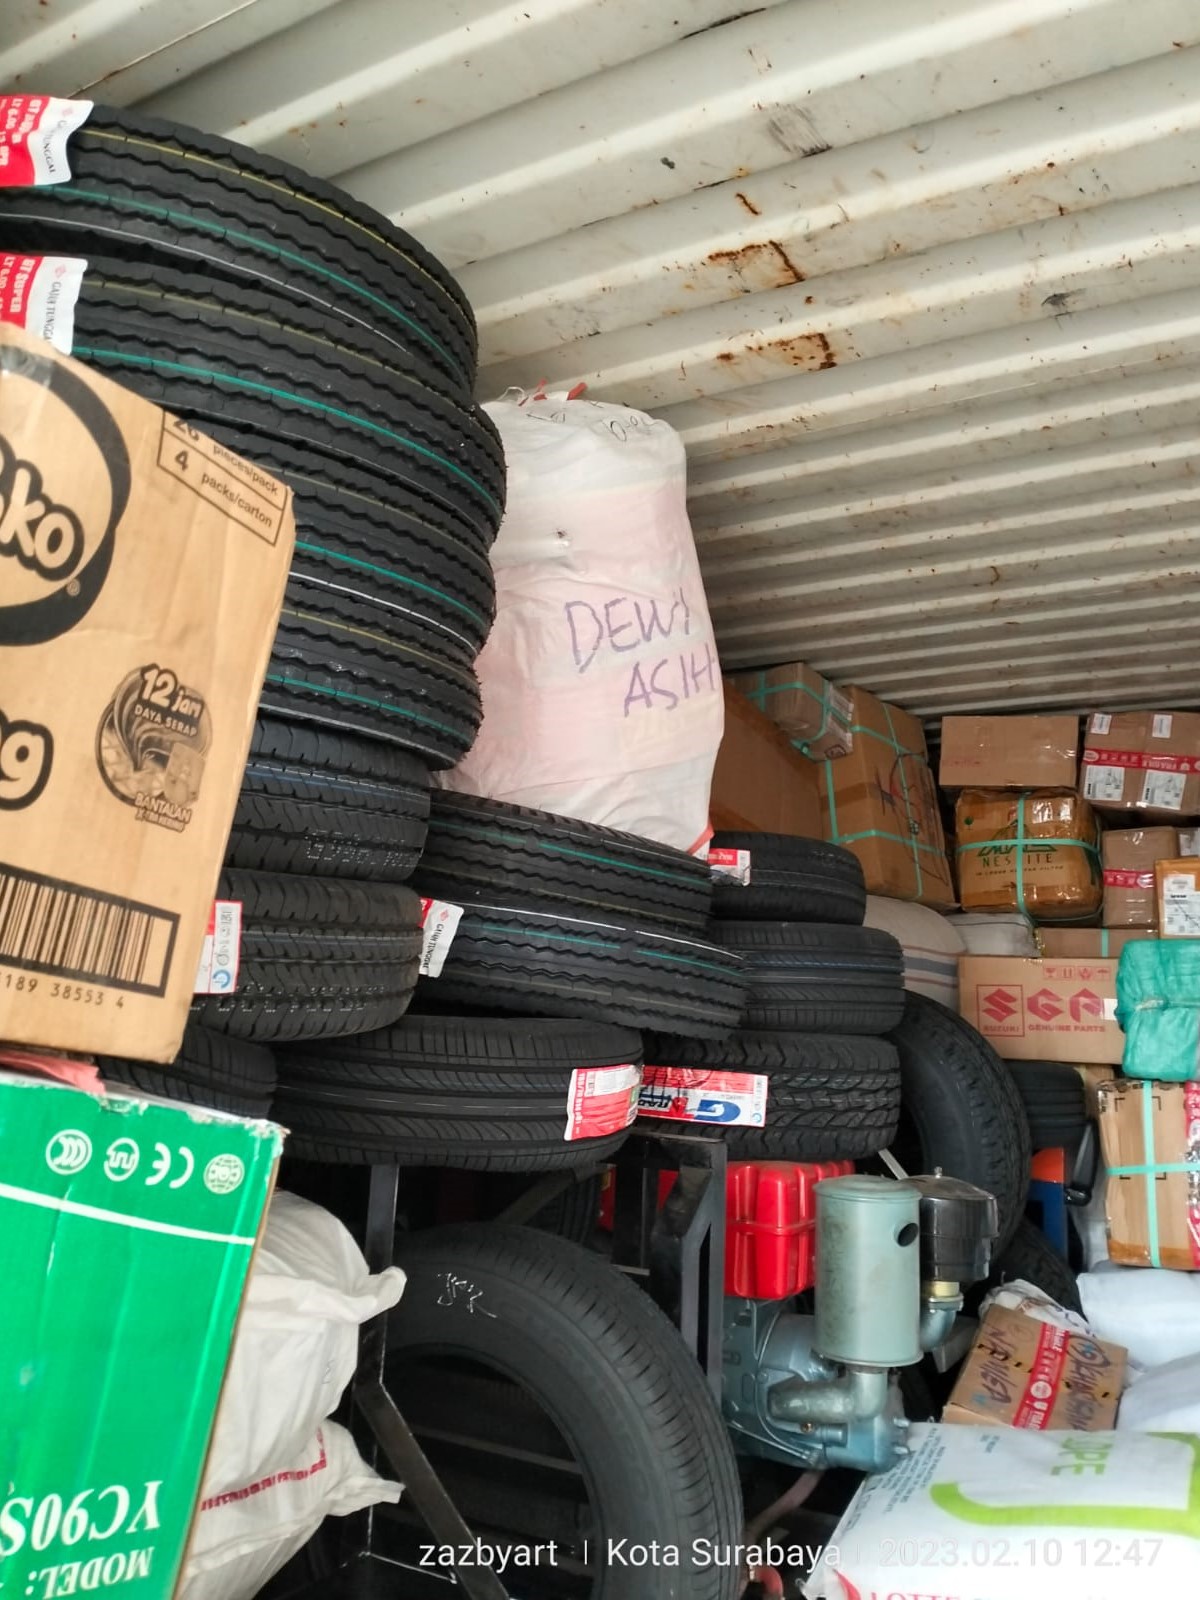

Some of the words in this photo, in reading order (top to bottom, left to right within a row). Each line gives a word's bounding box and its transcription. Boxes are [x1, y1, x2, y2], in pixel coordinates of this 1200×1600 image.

[174, 450, 189, 472] 4
[201, 472, 274, 528] packs/carton
[0, 464, 78, 572] ko
[564, 587, 690, 675] DEWI
[142, 667, 176, 709] 12
[171, 689, 204, 719] jam
[623, 642, 716, 718] ASIH
[133, 703, 164, 725] DAYA
[164, 717, 199, 738] SERAP
[133, 793, 192, 824] BANTALAN
[982, 853, 1053, 868] NESITE
[0, 972, 38, 993] 189
[50, 982, 105, 1006] 38553
[115, 995, 125, 1009] 4
[1028, 1024, 1071, 1033] GENUINE
[1074, 1024, 1106, 1033] PARTS
[25, 1546, 155, 1600] MODEL:
